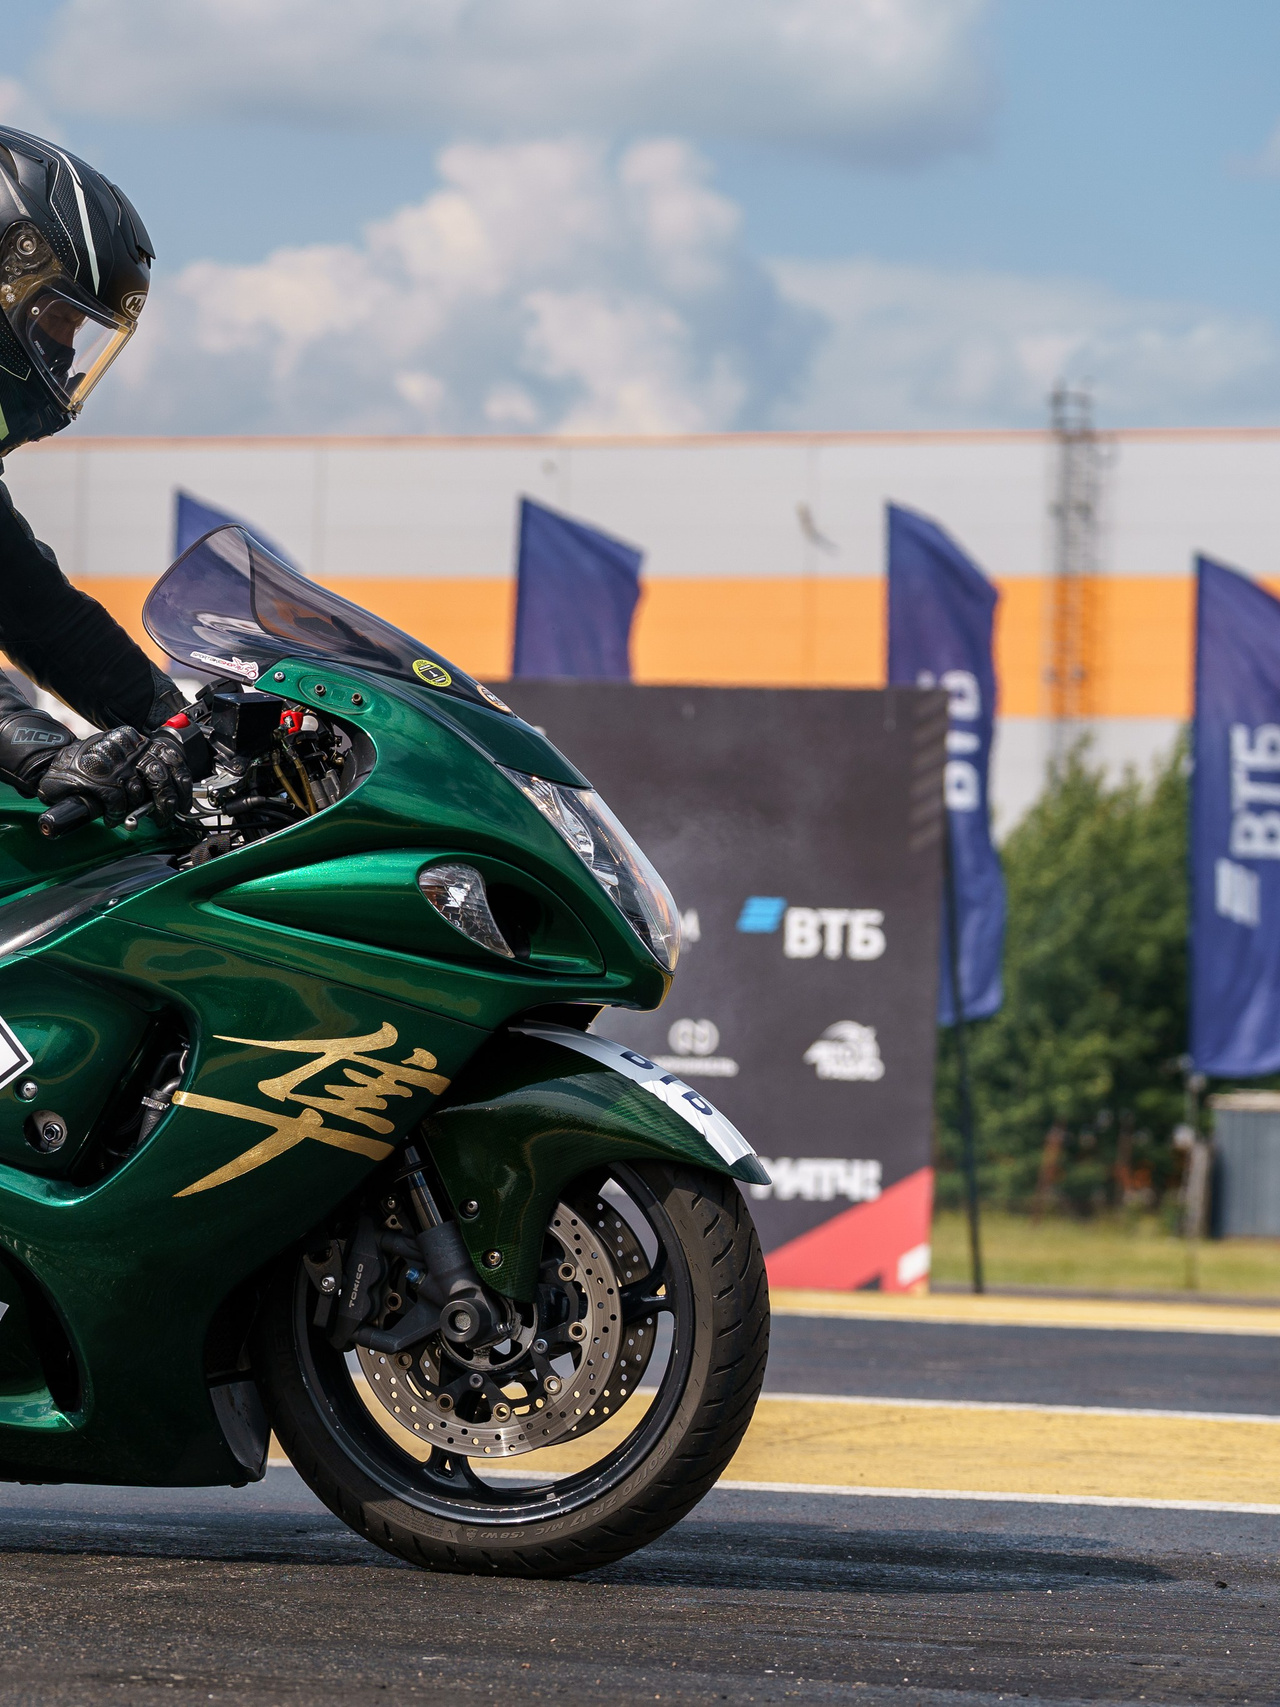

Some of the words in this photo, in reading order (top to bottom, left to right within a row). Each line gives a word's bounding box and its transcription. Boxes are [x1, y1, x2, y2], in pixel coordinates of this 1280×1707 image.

[126, 296, 146, 312] HJ
[12, 727, 65, 745] MCP
[783, 906, 887, 961] ВТБ
[348, 1263, 364, 1308] TOKICO
[592, 1494, 618, 1517] ZR
[570, 1512, 588, 1527] 17
[480, 1531, 525, 1539] (58W)
[535, 1521, 565, 1536] M/C
